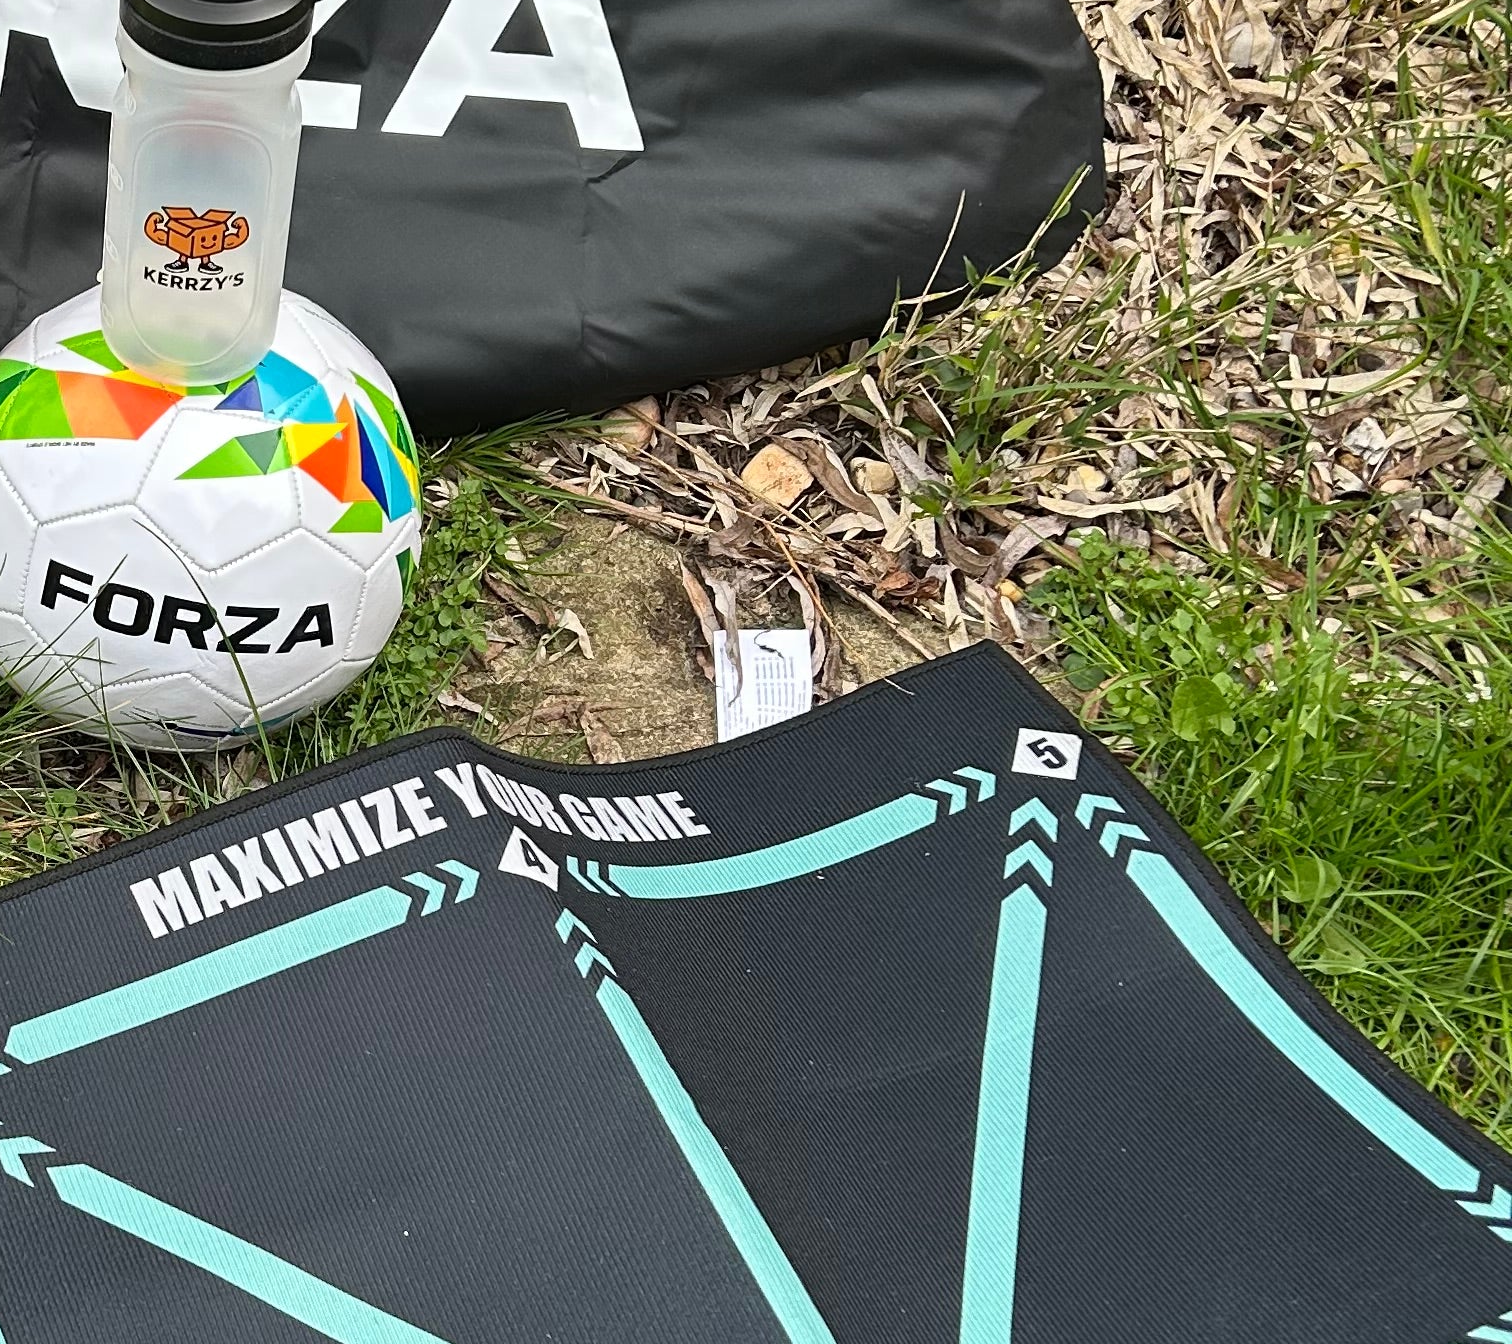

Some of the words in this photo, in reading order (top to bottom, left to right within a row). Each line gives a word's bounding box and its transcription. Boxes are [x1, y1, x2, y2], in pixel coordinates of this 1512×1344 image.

[143, 266, 245, 292] KERRZY'S
[40, 559, 335, 654] FORZA
[1026, 736, 1068, 770] 5
[129, 776, 448, 939] MAXIMIZE
[434, 762, 573, 836] YOUR
[558, 790, 712, 843] GAME
[522, 837, 549, 874] 4
